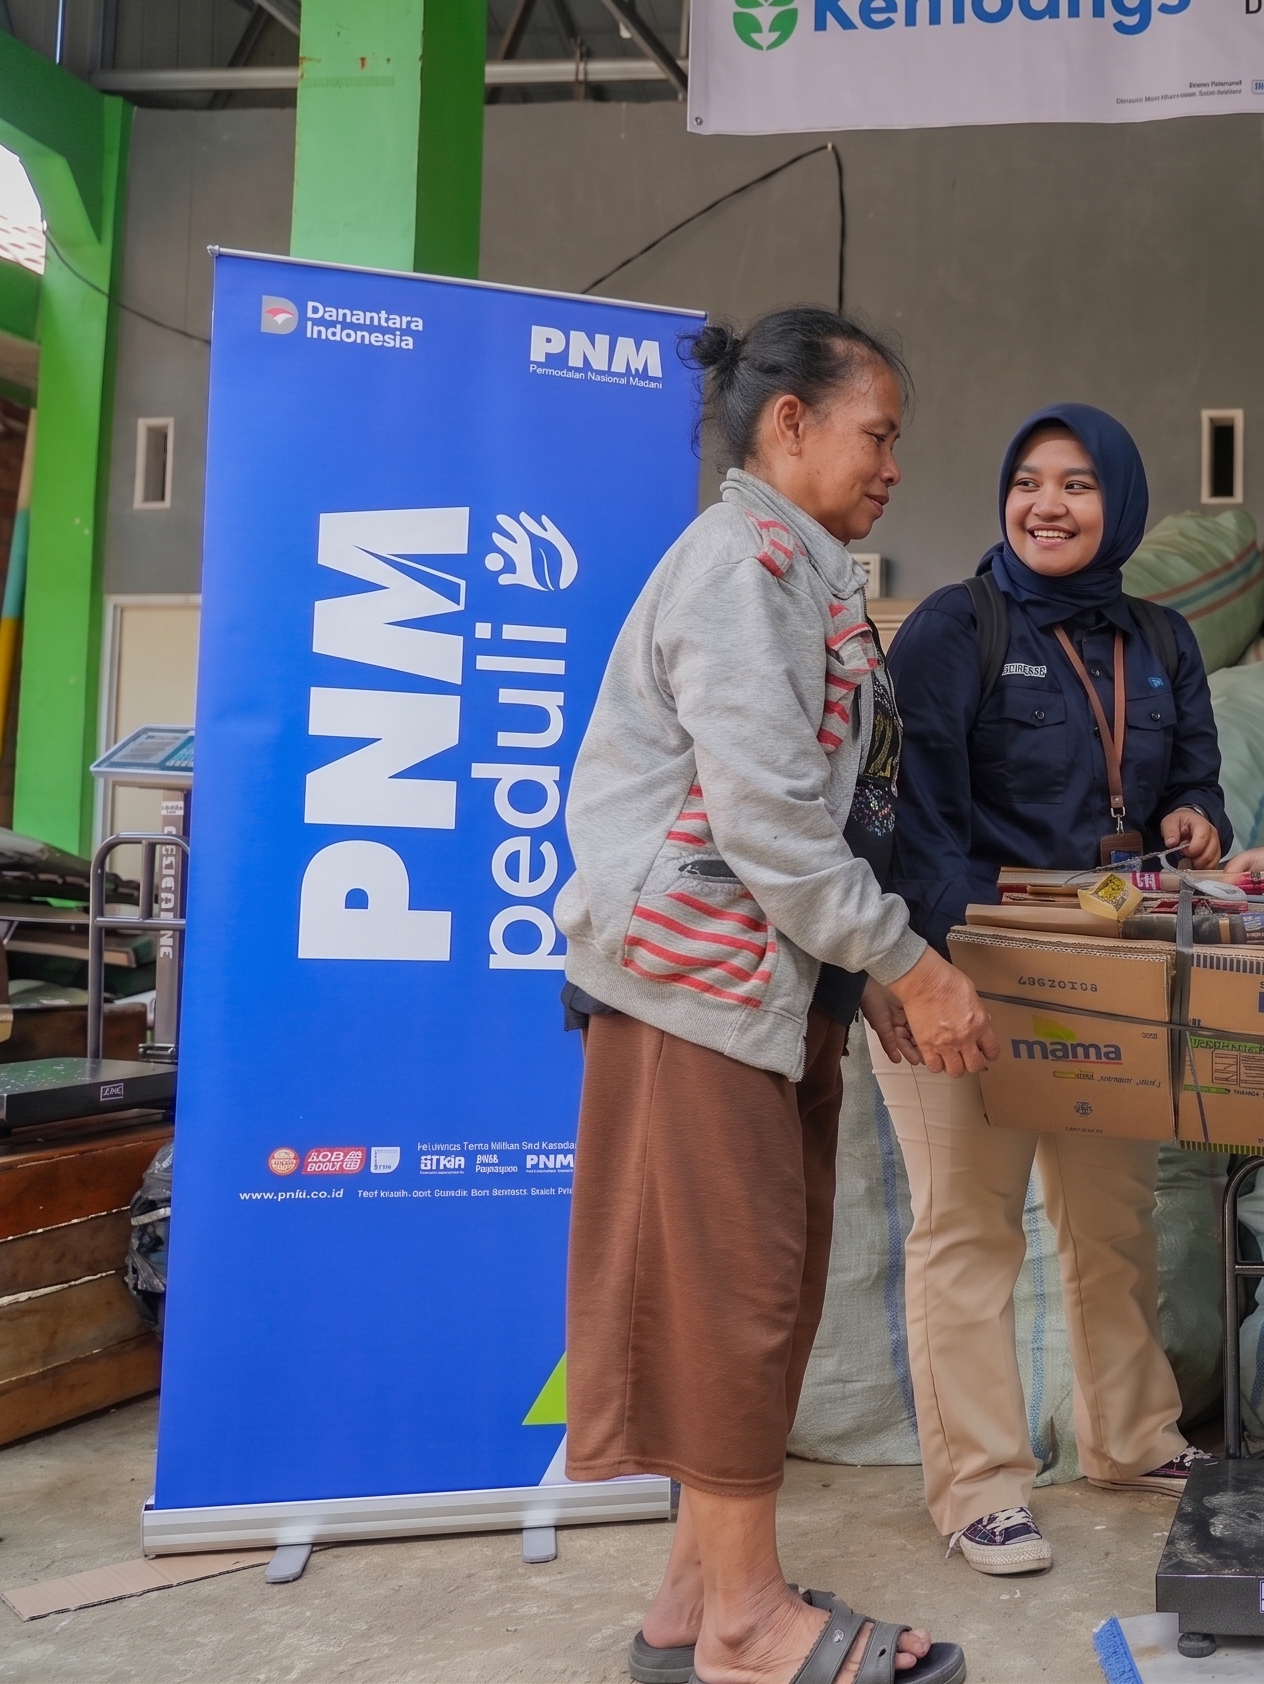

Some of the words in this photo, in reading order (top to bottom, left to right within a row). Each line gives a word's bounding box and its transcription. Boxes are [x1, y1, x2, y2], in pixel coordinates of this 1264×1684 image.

[307, 300, 424, 331] Danantara
[306, 321, 414, 350] Indonesia
[530, 325, 662, 378] PNM
[529, 364, 585, 380] Permodalan
[587, 371, 627, 385] Nasional
[629, 376, 663, 390] Madani
[297, 506, 470, 962] PNM
[471, 622, 567, 971] peduli
[1011, 1038, 1123, 1062] mama
[525, 1153, 575, 1169] PNM
